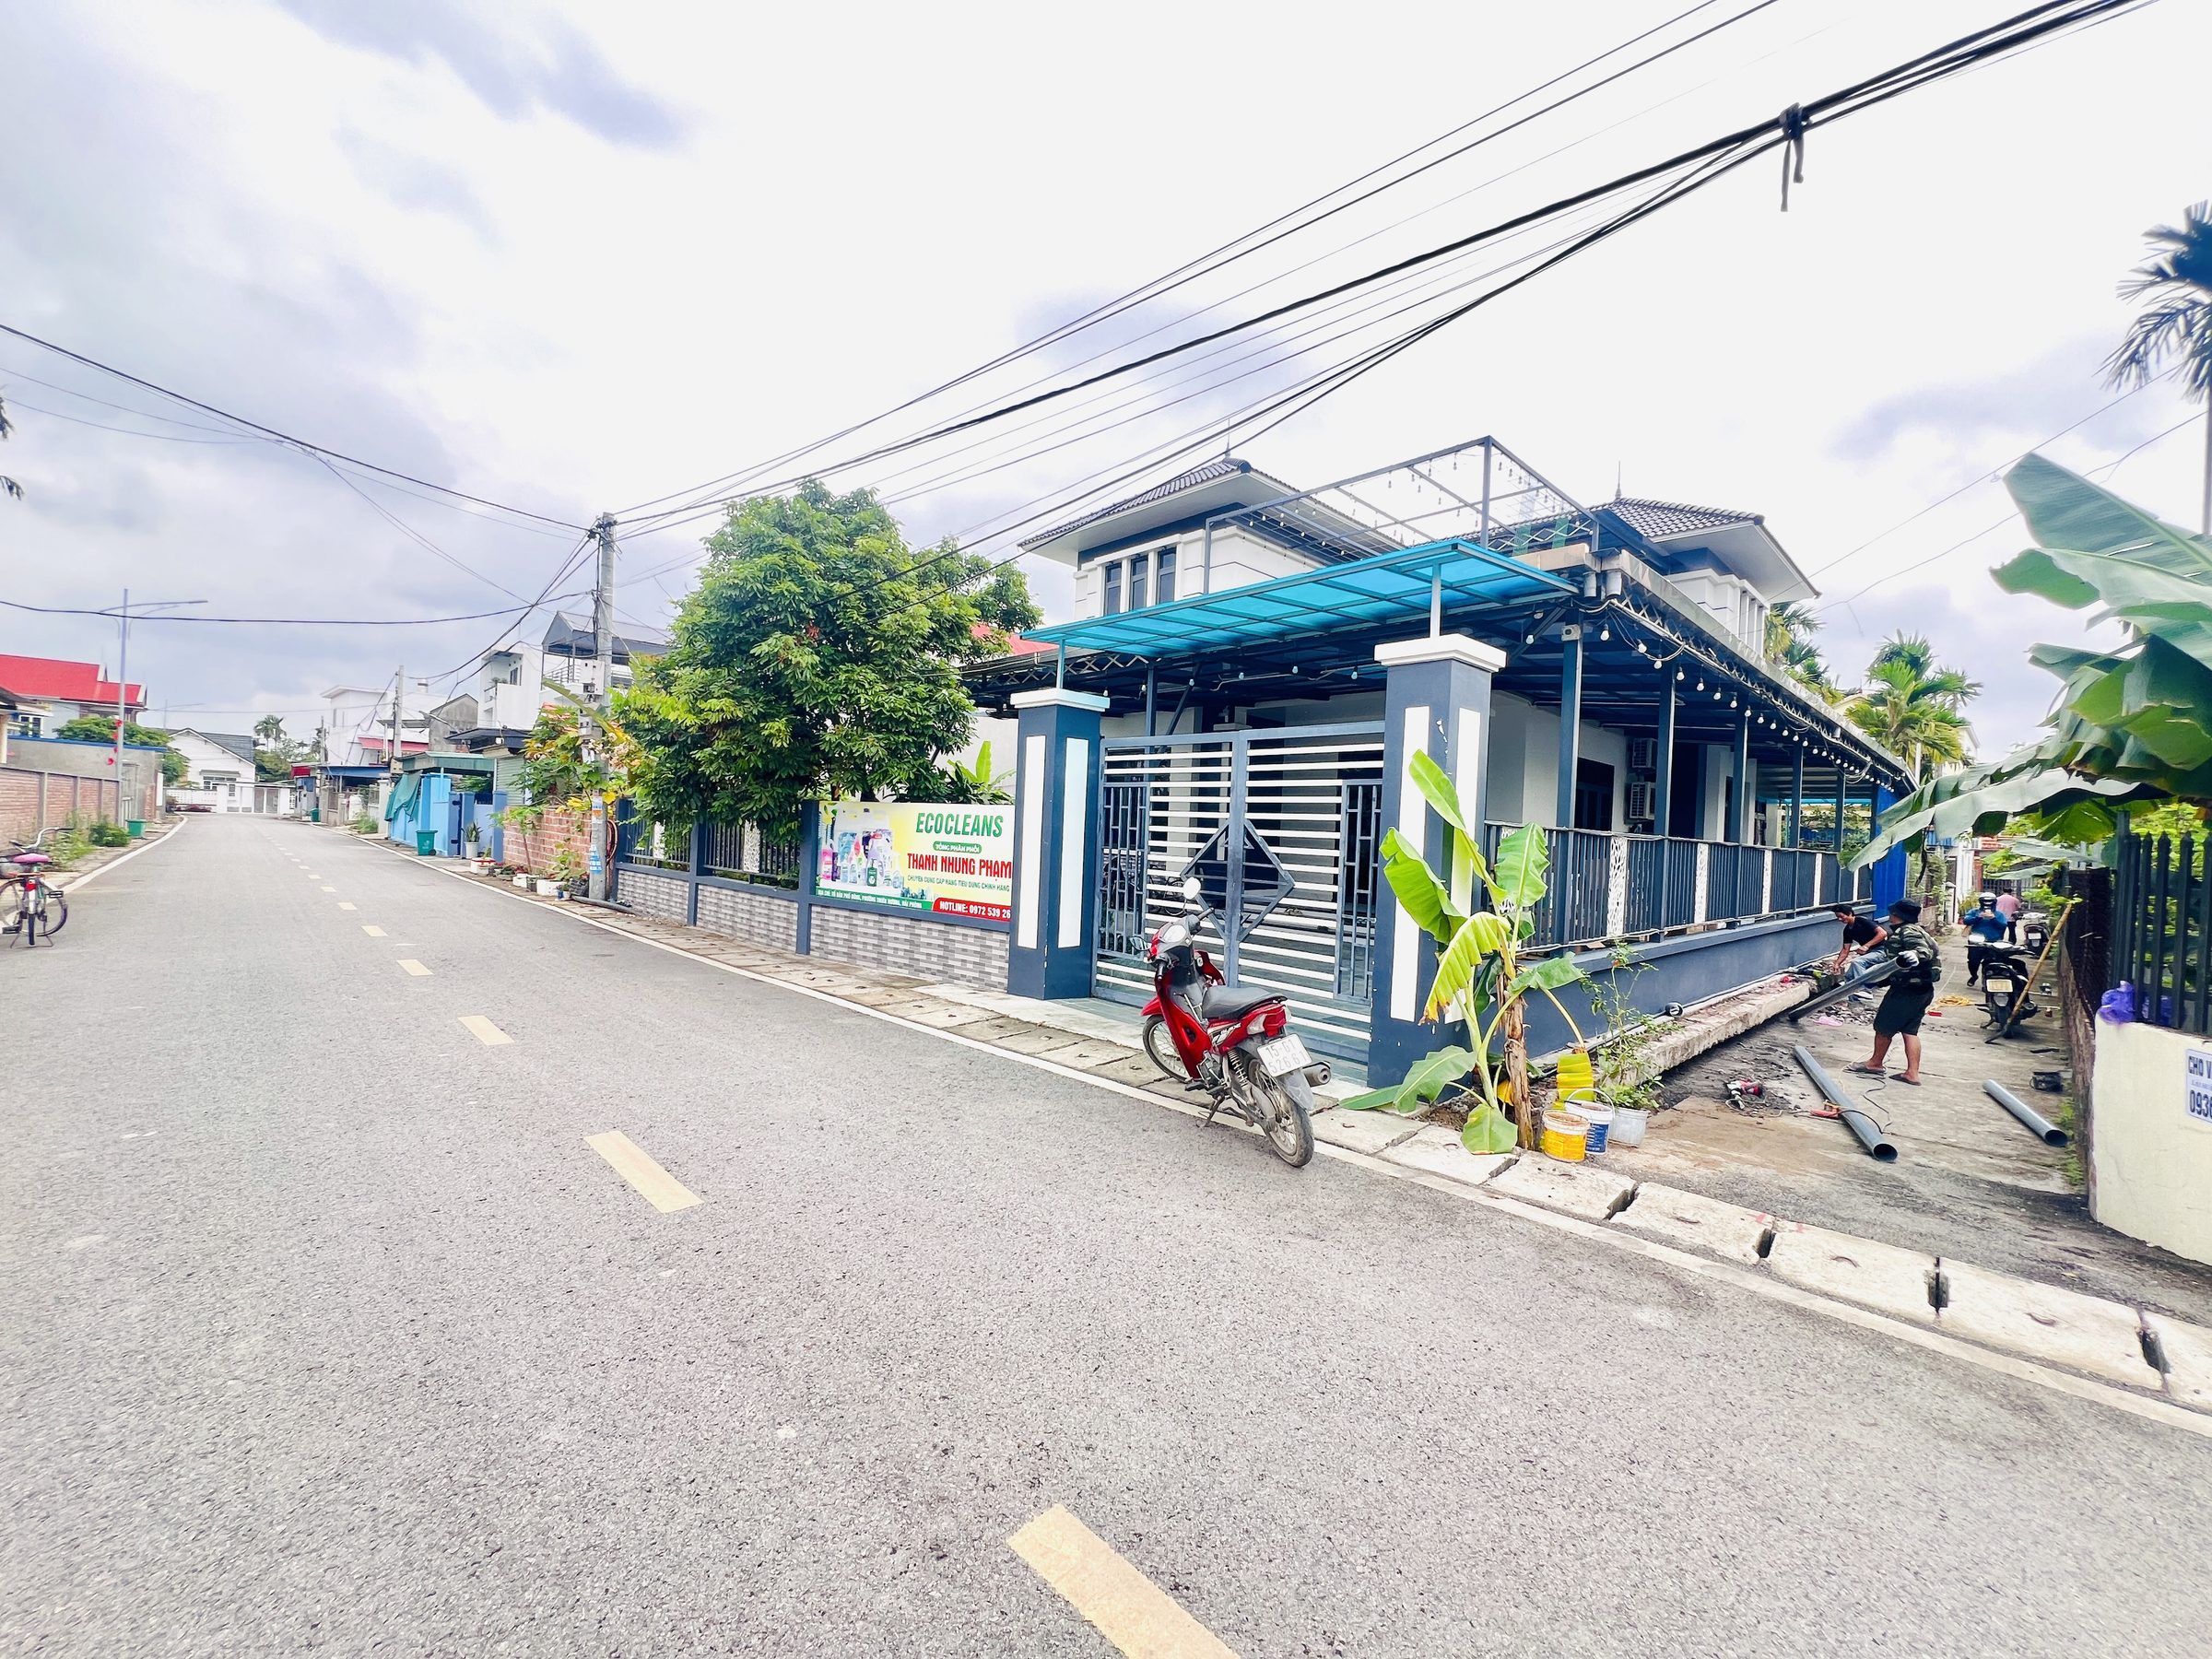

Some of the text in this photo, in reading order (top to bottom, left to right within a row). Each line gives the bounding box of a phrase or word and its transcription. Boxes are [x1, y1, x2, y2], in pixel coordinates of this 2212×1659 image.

[916, 812, 1004, 838] ECOCLEANS
[907, 853, 1012, 881] THANH NHUNG PHẠM
[939, 900, 968, 912] HOTLINE:
[969, 904, 986, 915] 0972
[987, 907, 1001, 917] 539
